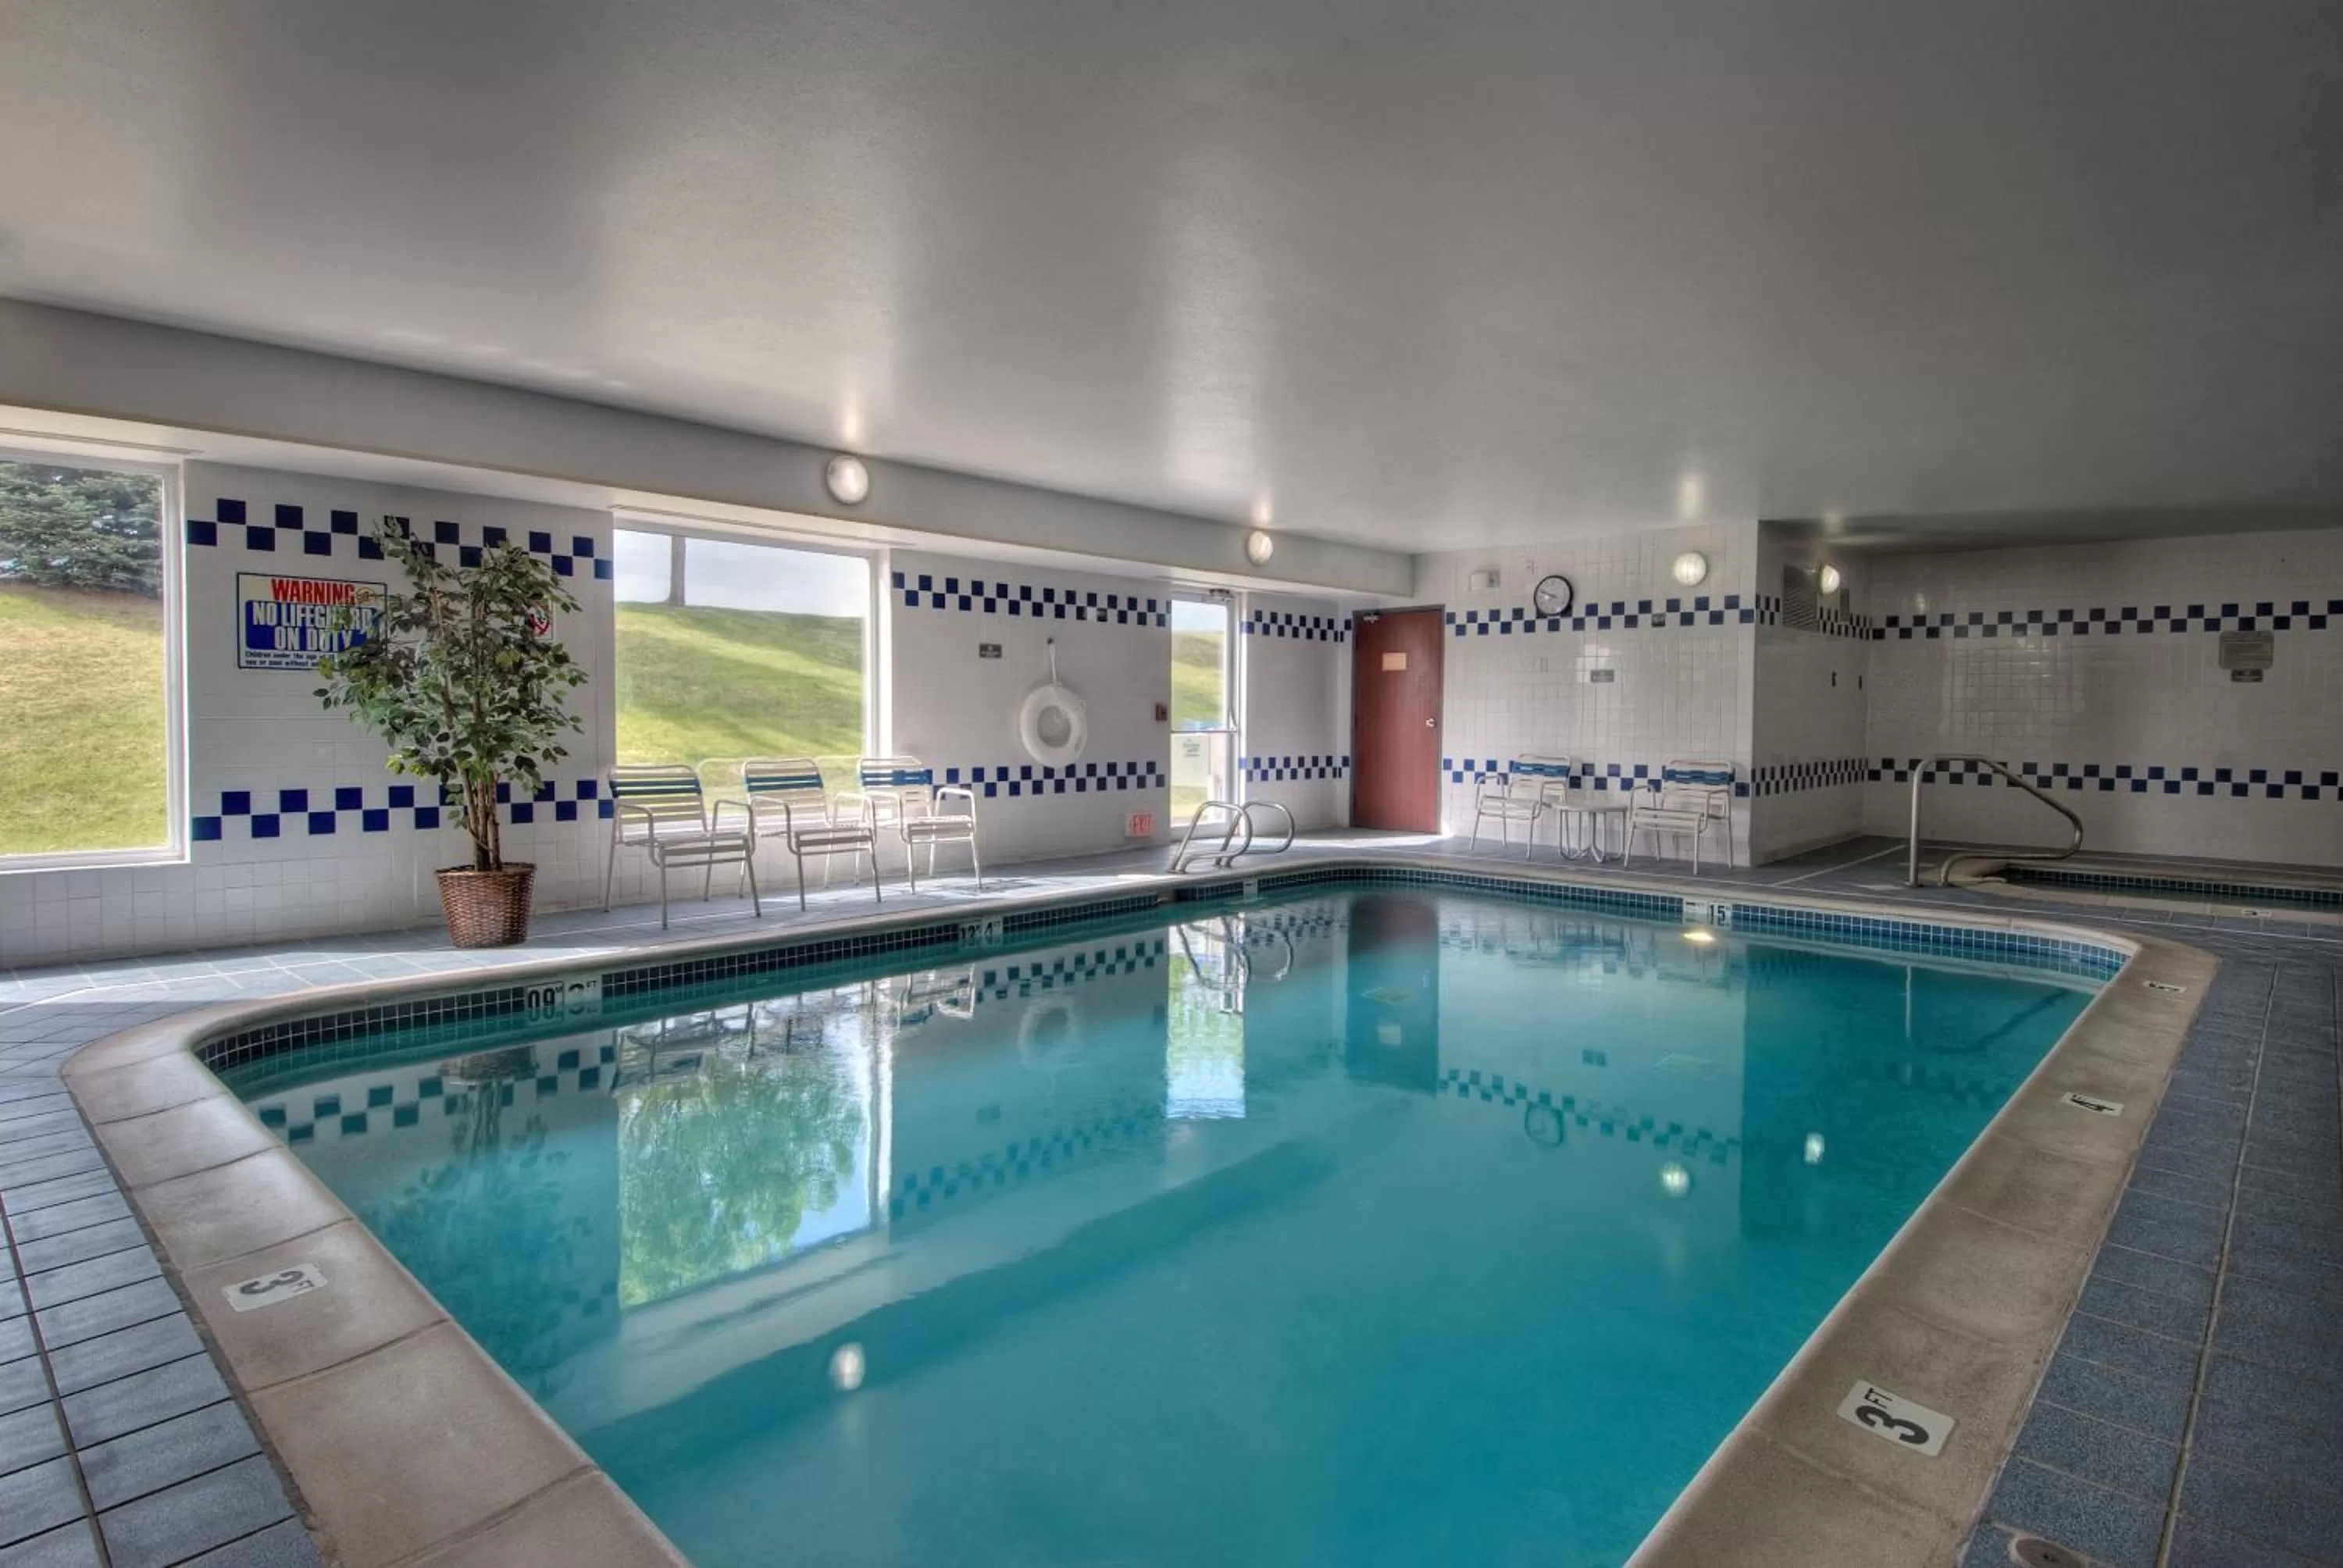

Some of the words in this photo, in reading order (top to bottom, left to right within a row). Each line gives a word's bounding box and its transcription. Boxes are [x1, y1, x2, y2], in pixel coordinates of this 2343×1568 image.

[271, 579, 356, 605] WARNING
[252, 602, 276, 626] NO
[281, 603, 373, 630] LIFEGURD
[274, 626, 300, 650] ON
[305, 628, 352, 652] DUTY
[239, 1270, 304, 1295] 3
[1864, 1387, 1893, 1409] FT
[1855, 1405, 1929, 1444] 3
